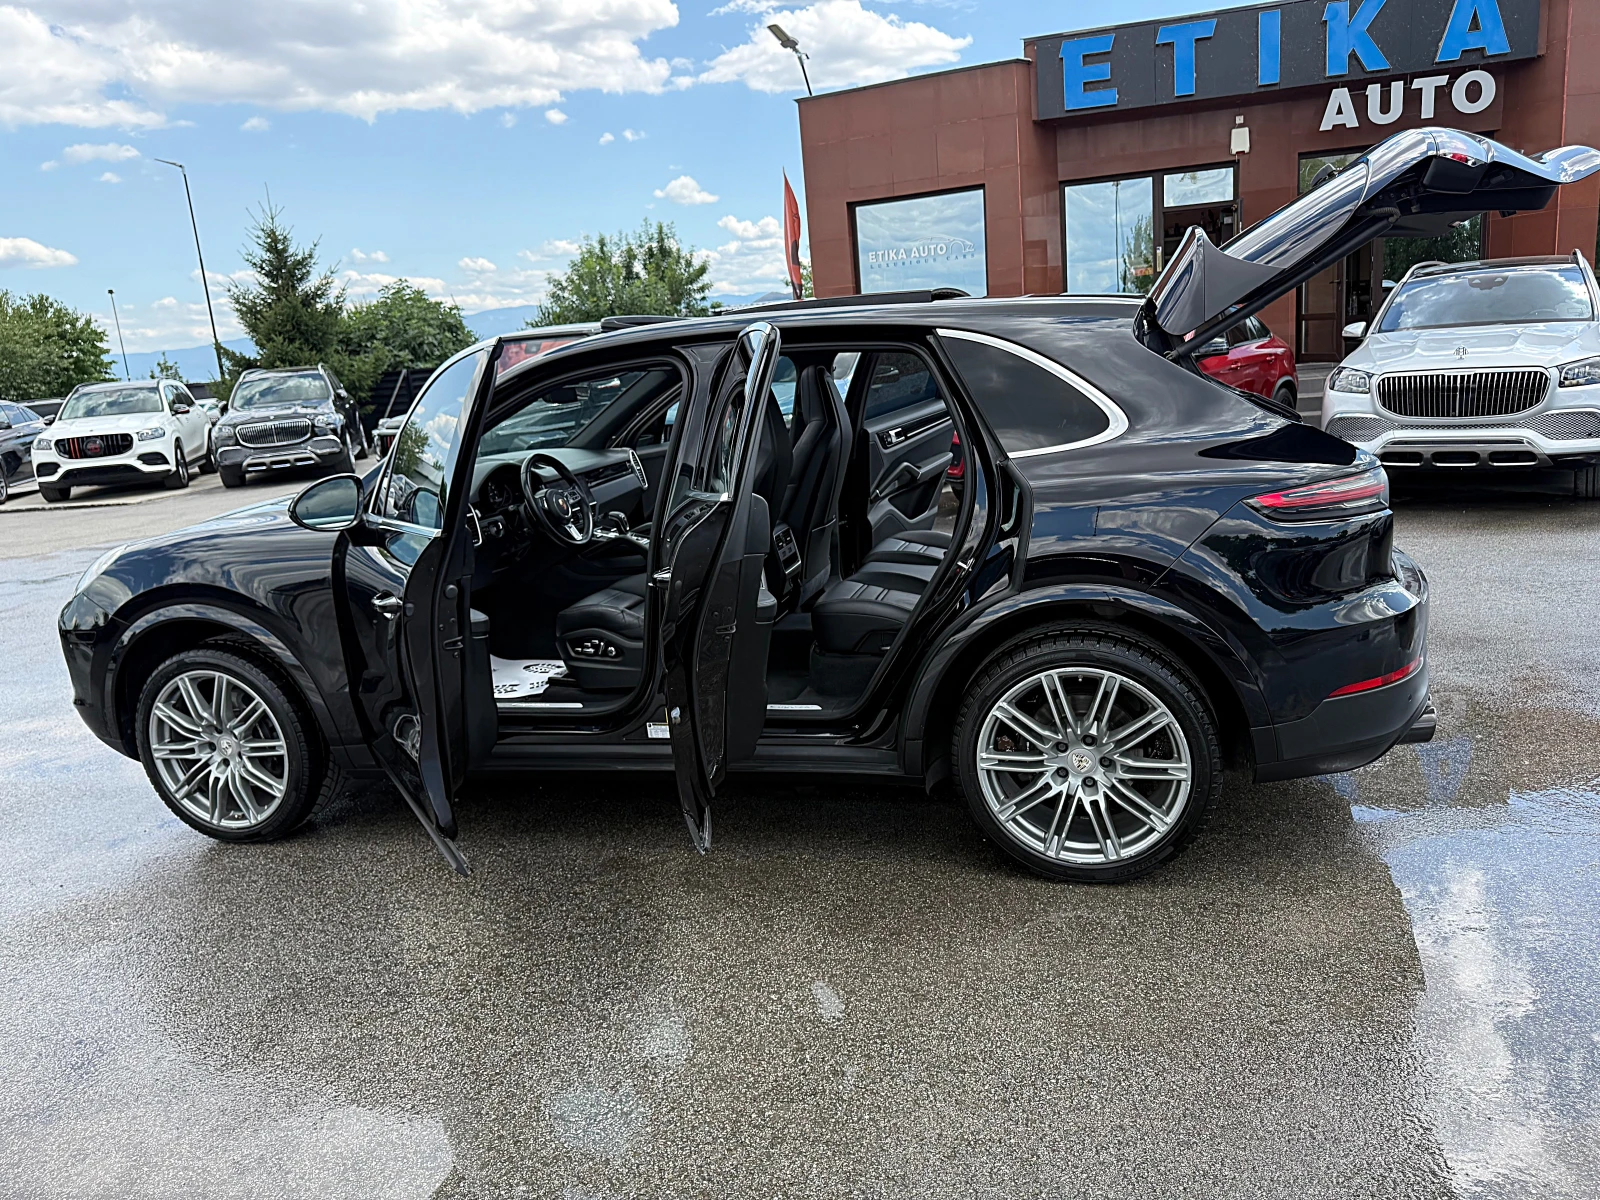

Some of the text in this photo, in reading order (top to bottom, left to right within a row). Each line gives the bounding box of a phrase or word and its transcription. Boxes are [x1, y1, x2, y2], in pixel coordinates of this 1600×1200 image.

[1059, 0, 1511, 111] ETIKA
[1319, 69, 1497, 131] AUTO
[868, 243, 947, 263] ETIKA AUTO
[870, 252, 975, 270] LUXURIOUS CARS
